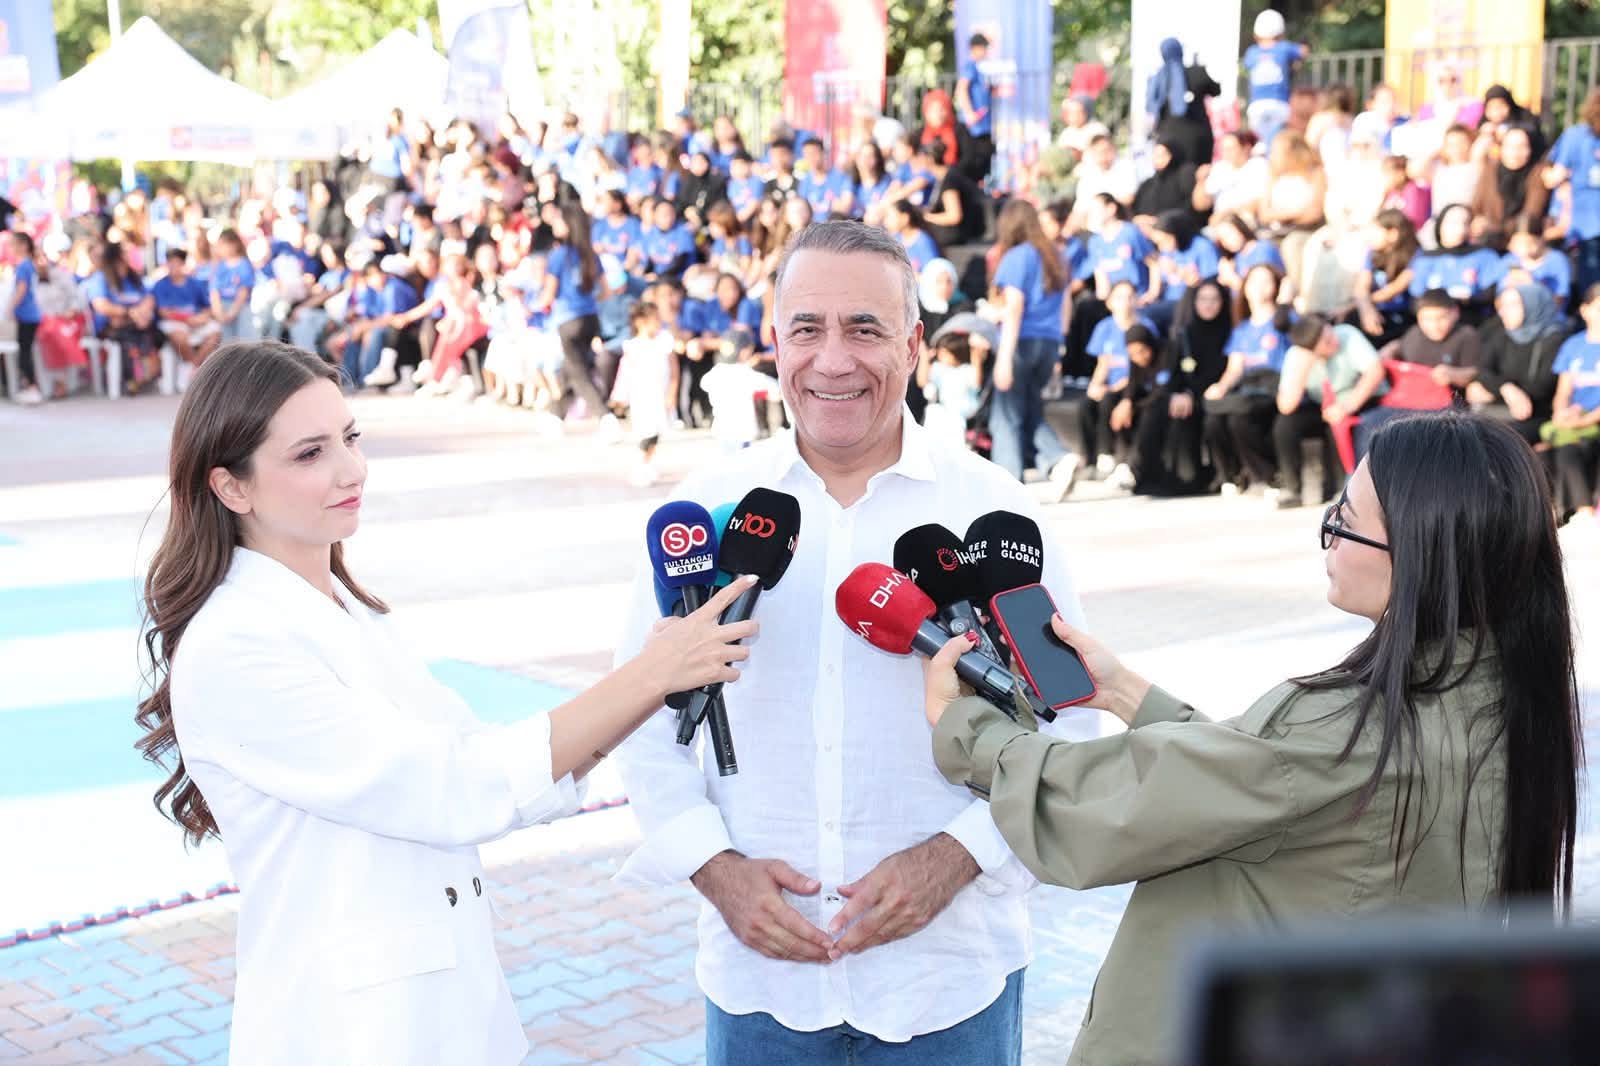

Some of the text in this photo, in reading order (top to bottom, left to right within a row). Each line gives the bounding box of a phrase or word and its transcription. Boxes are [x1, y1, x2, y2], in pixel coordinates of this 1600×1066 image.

[729, 513, 776, 538] tv100
[1001, 539, 1040, 558] HABER
[1001, 549, 1040, 568] GLOBAL
[677, 563, 704, 574] OLAY
[869, 571, 908, 609] DHA
